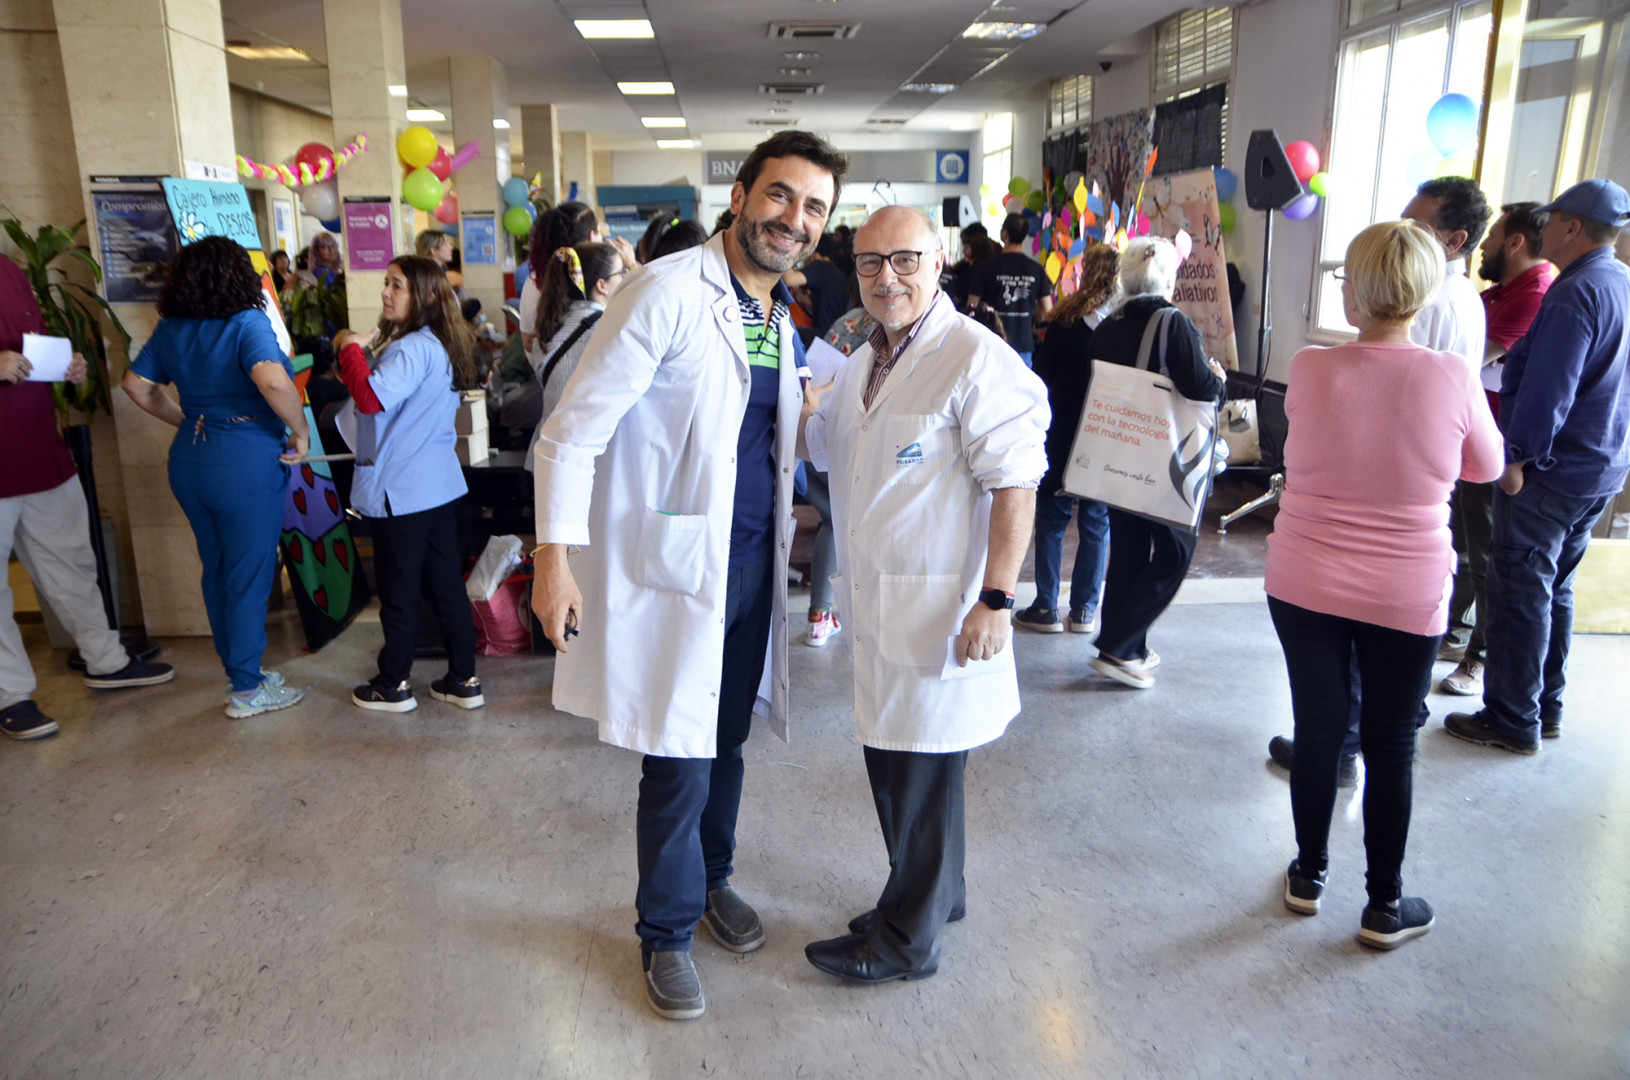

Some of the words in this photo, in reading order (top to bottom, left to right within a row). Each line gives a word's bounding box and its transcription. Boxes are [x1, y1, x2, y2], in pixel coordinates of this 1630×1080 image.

[173, 185, 207, 216] Cajero
[209, 187, 240, 207] Humano
[204, 216, 215, 235] de
[217, 211, 256, 237] DESEOS
[1176, 259, 1216, 279] idados
[1087, 413, 1105, 423] con
[1107, 415, 1116, 426] la
[1093, 399, 1103, 409] Te
[1104, 403, 1152, 423] cuidamos
[1153, 415, 1172, 430] hoy
[1084, 424, 1099, 435] del
